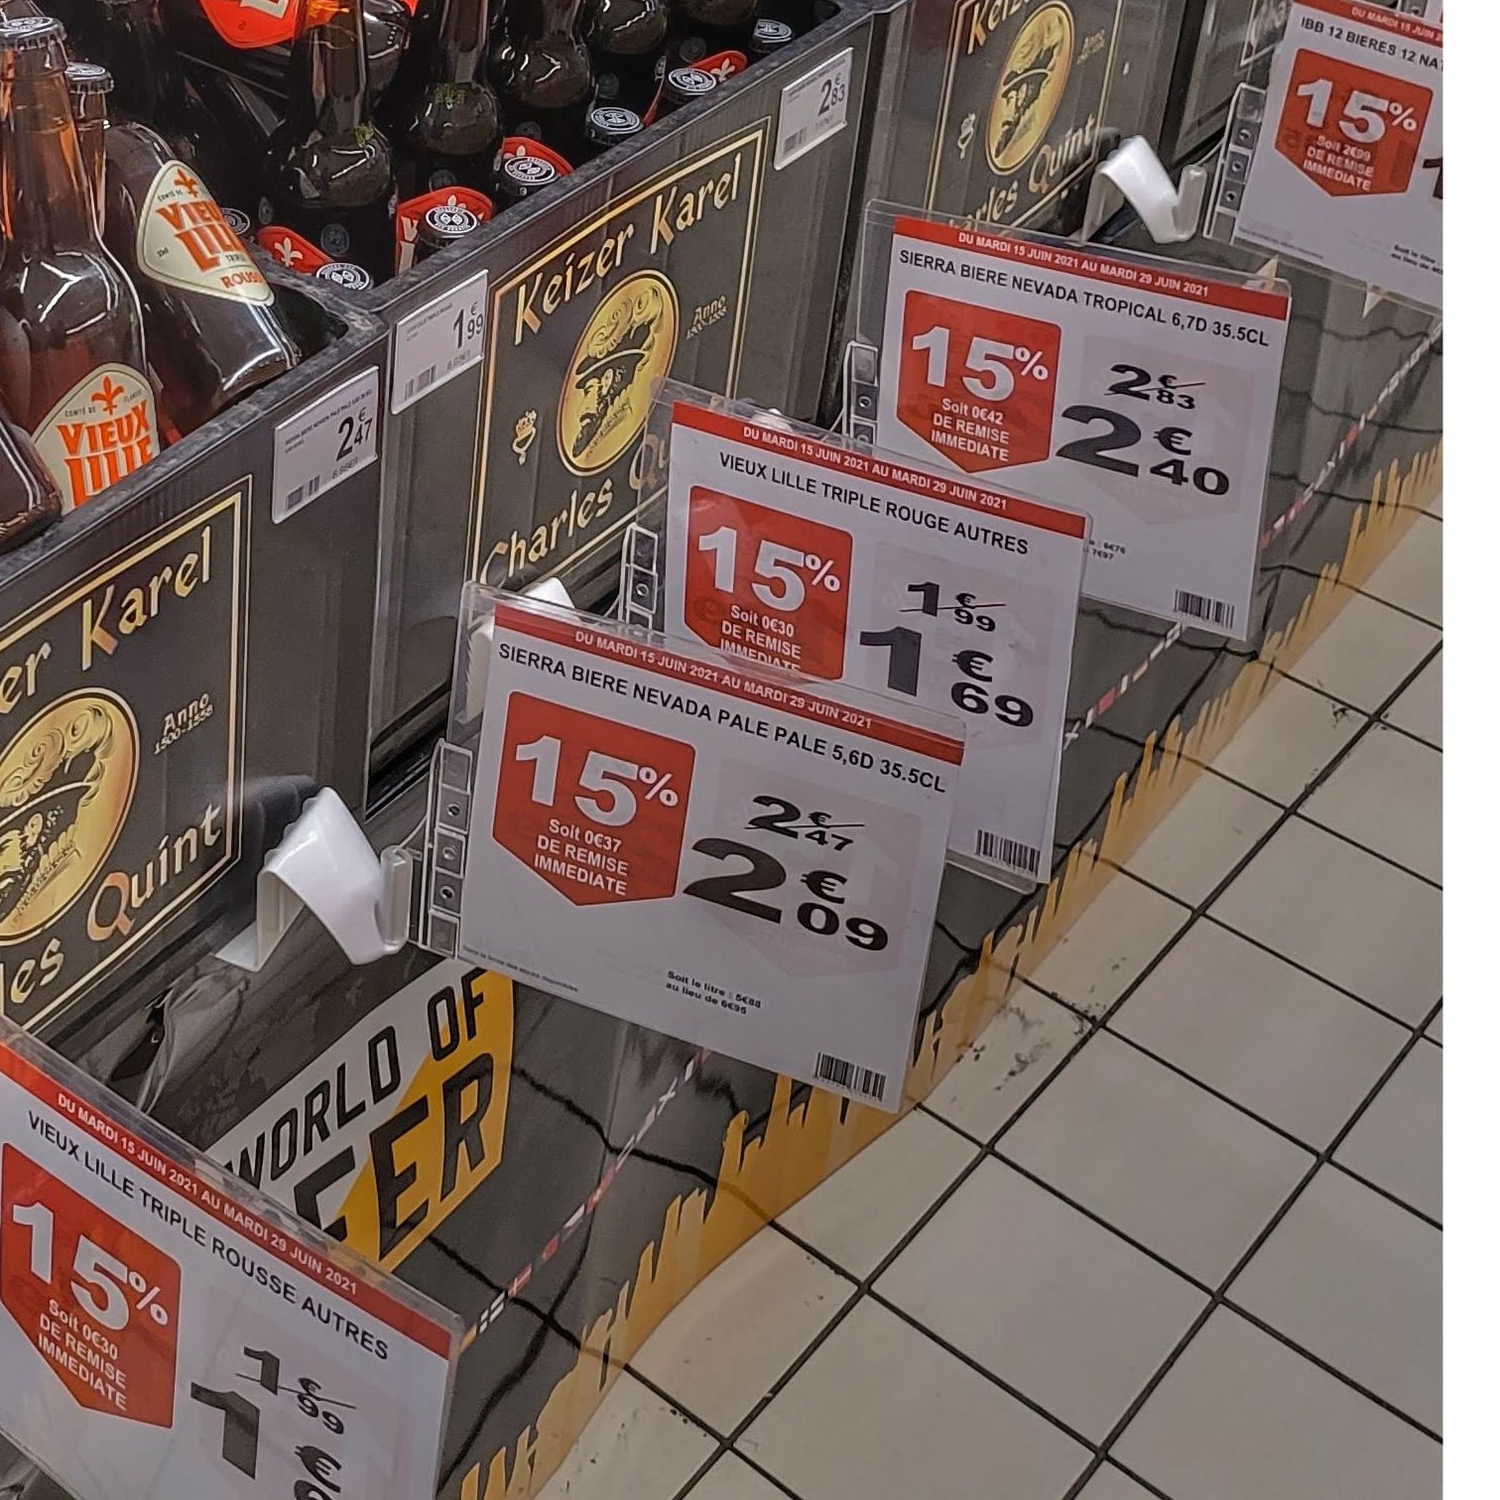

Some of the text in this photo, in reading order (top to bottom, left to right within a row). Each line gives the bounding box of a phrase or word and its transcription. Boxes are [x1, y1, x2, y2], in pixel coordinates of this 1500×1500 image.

[1329, 26, 1343, 39] 12
[1346, 31, 1396, 56] BIERES
[1402, 49, 1416, 62] 12
[514, 153, 743, 347] Keizer Karel
[900, 250, 1269, 346] SIERRA BIERE NEVADA TROPICAL 6,7D 35.5CL
[56, 400, 150, 459] VIEUX
[720, 452, 1028, 554] VIEUX LILLE TRIPLE ROUGE AUTRES
[80, 524, 212, 671] Karel
[731, 605, 794, 637] Soit 0€30
[722, 620, 801, 659] DE REMISE
[163, 691, 210, 731] Anno
[499, 643, 945, 793] SIERRA BIERE NEVADA PALE PALE 5,6D 35.5CL
[538, 835, 628, 879] DE REMISE
[549, 819, 621, 852] Soit 0€37
[86, 802, 222, 943] Quint
[534, 851, 628, 896] IMMEDIATE
[668, 971, 688, 984] Soit
[704, 982, 725, 996] litre
[682, 986, 701, 999] lieu
[704, 995, 718, 1004] de
[427, 967, 491, 1062] OF
[58, 1093, 356, 1295] DU MARDI 15 JUIN 2021 AU MARDI 29 JUIN 2021
[29, 1110, 388, 1360] VIEUX LILLE TRIPLE ROUSSE AUTRES
